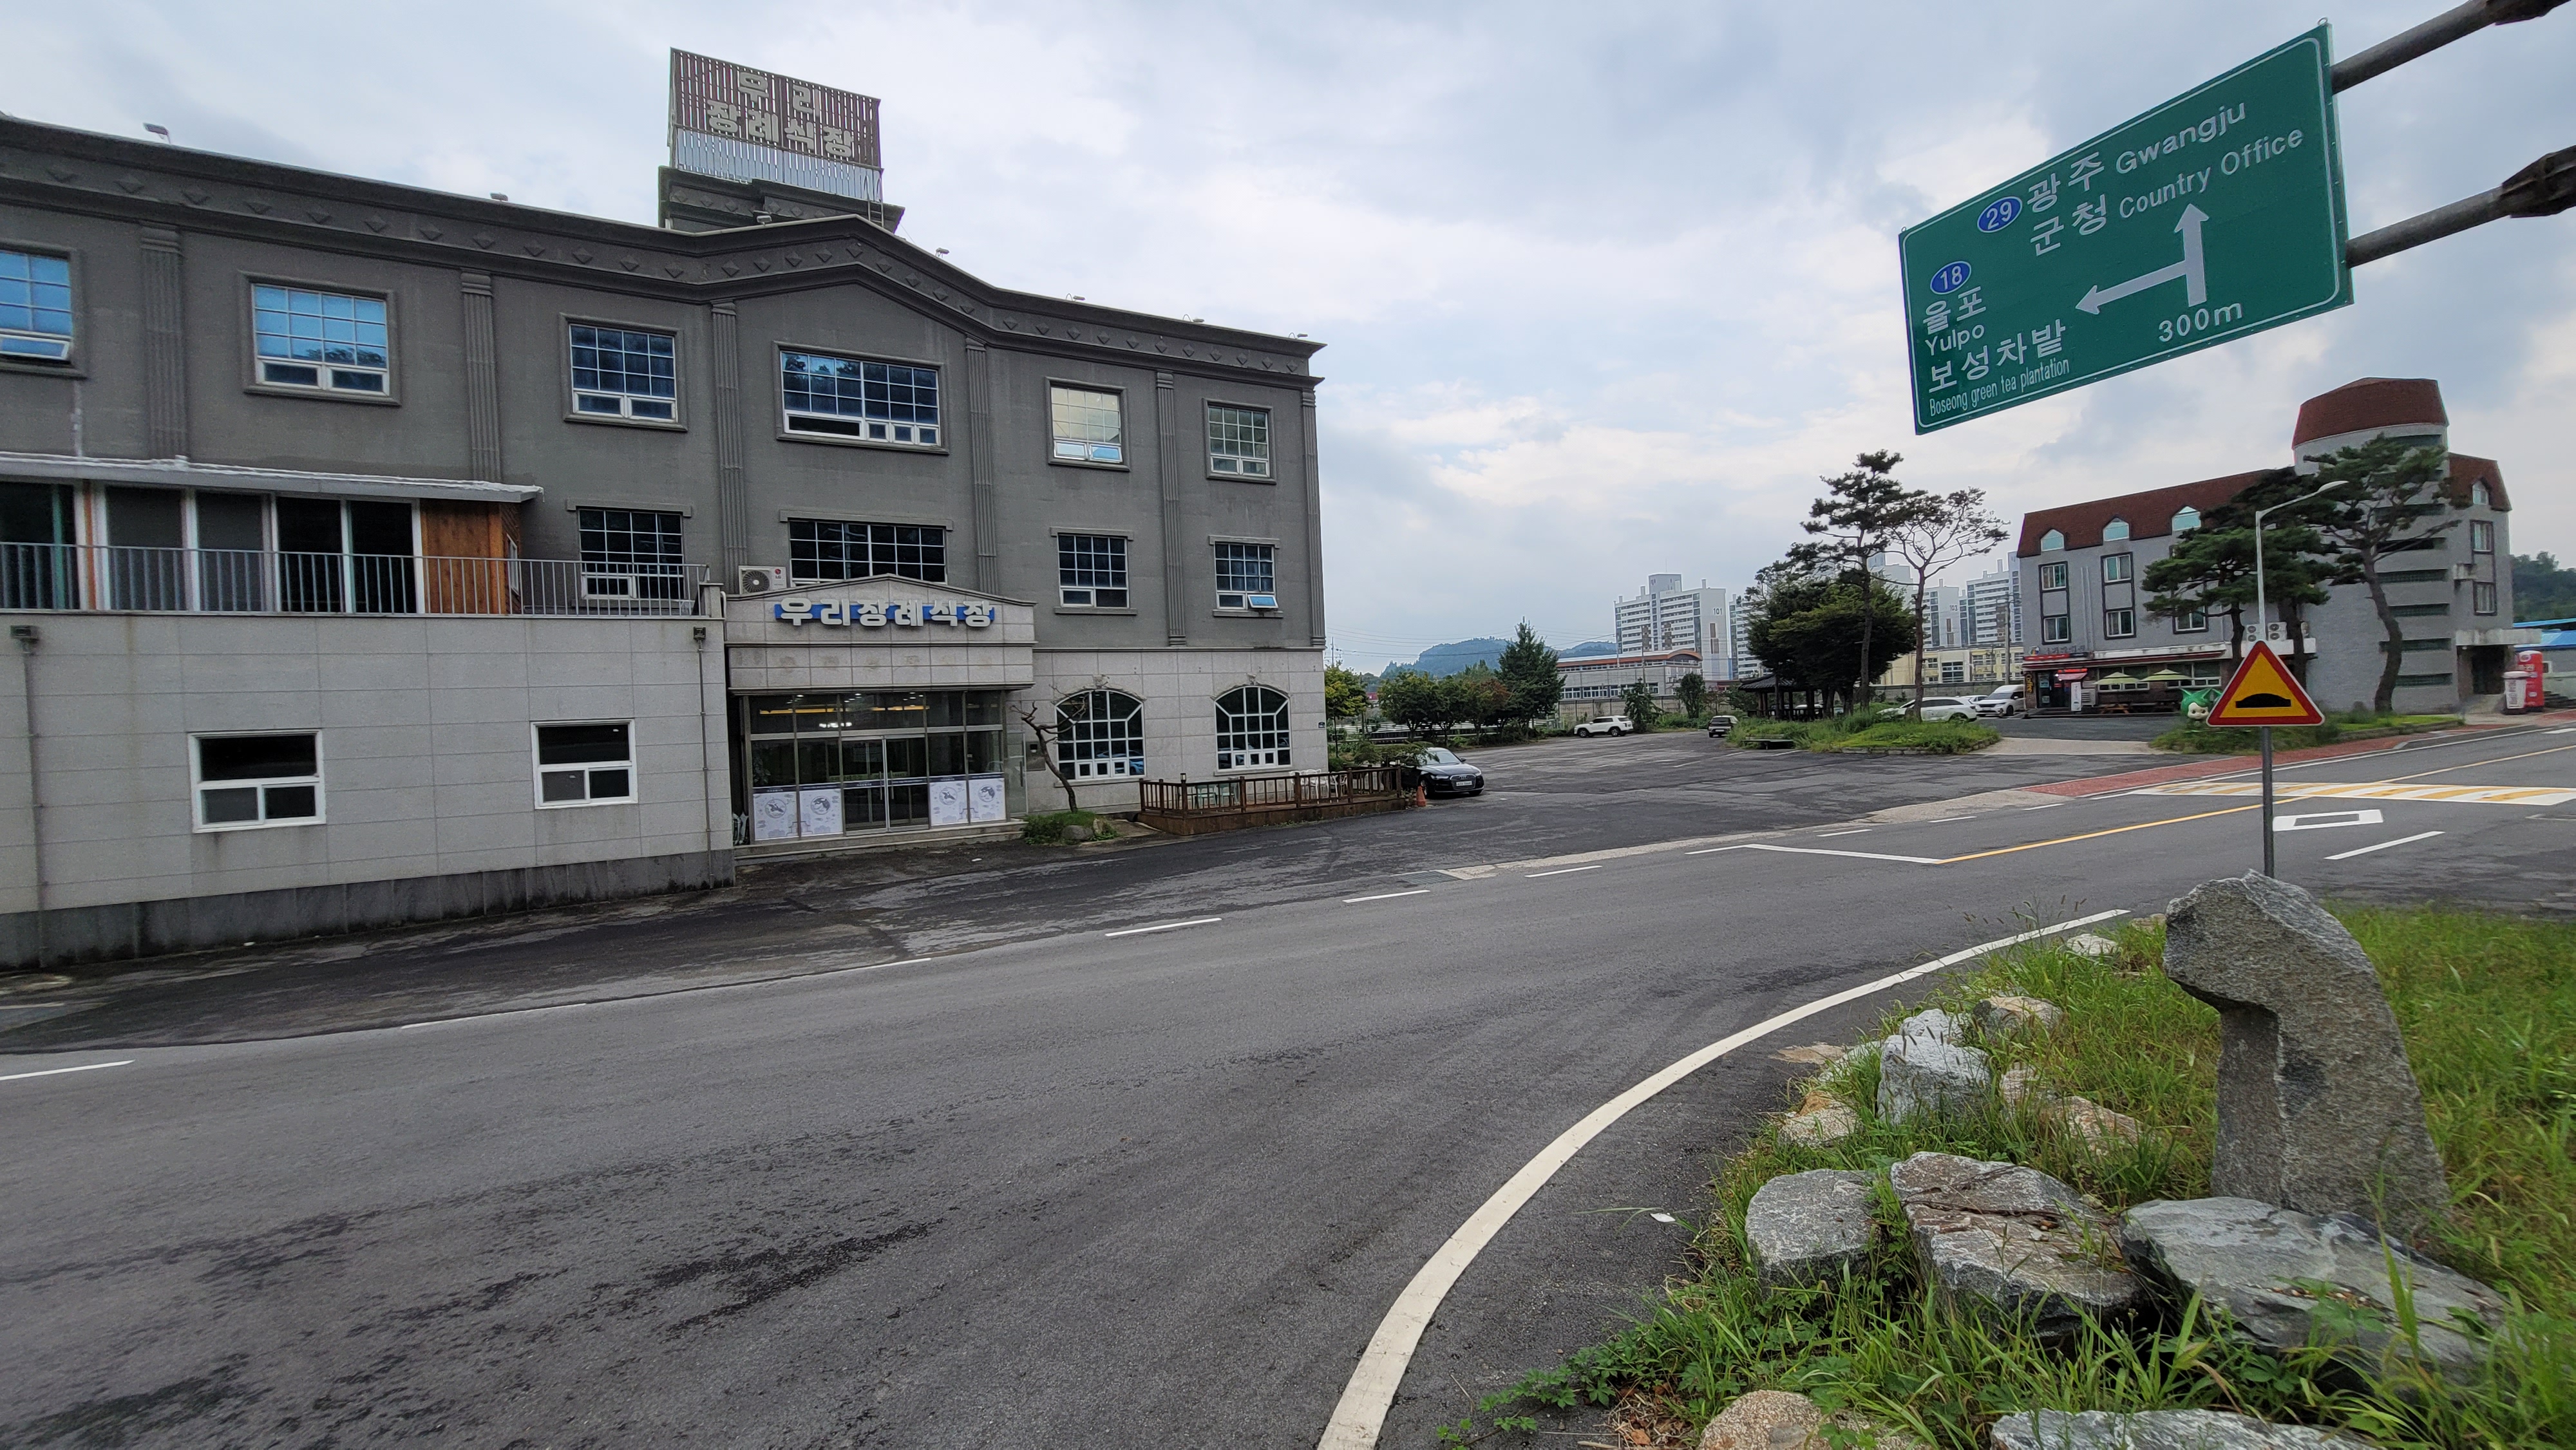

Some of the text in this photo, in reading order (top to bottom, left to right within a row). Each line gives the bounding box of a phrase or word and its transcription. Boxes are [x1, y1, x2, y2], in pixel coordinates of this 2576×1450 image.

[739, 71, 820, 117] 우리
[707, 99, 853, 158] 장례식장
[2116, 102, 2246, 174] Gwangju
[2027, 151, 2105, 213] 광주
[2119, 129, 2304, 218] Country Office
[1986, 201, 2013, 231] 29
[2030, 194, 2107, 257] 군청
[1940, 265, 1963, 290] 18
[1922, 286, 1987, 335] 율포
[2158, 303, 2242, 342] 300m
[1924, 325, 1985, 356] Yulpo
[1928, 319, 2066, 393] 보성차밭
[1929, 357, 2070, 417] Boseong green tea plantation
[780, 597, 995, 628] 우리장례식장
[2025, 673, 2034, 693] Coffee
